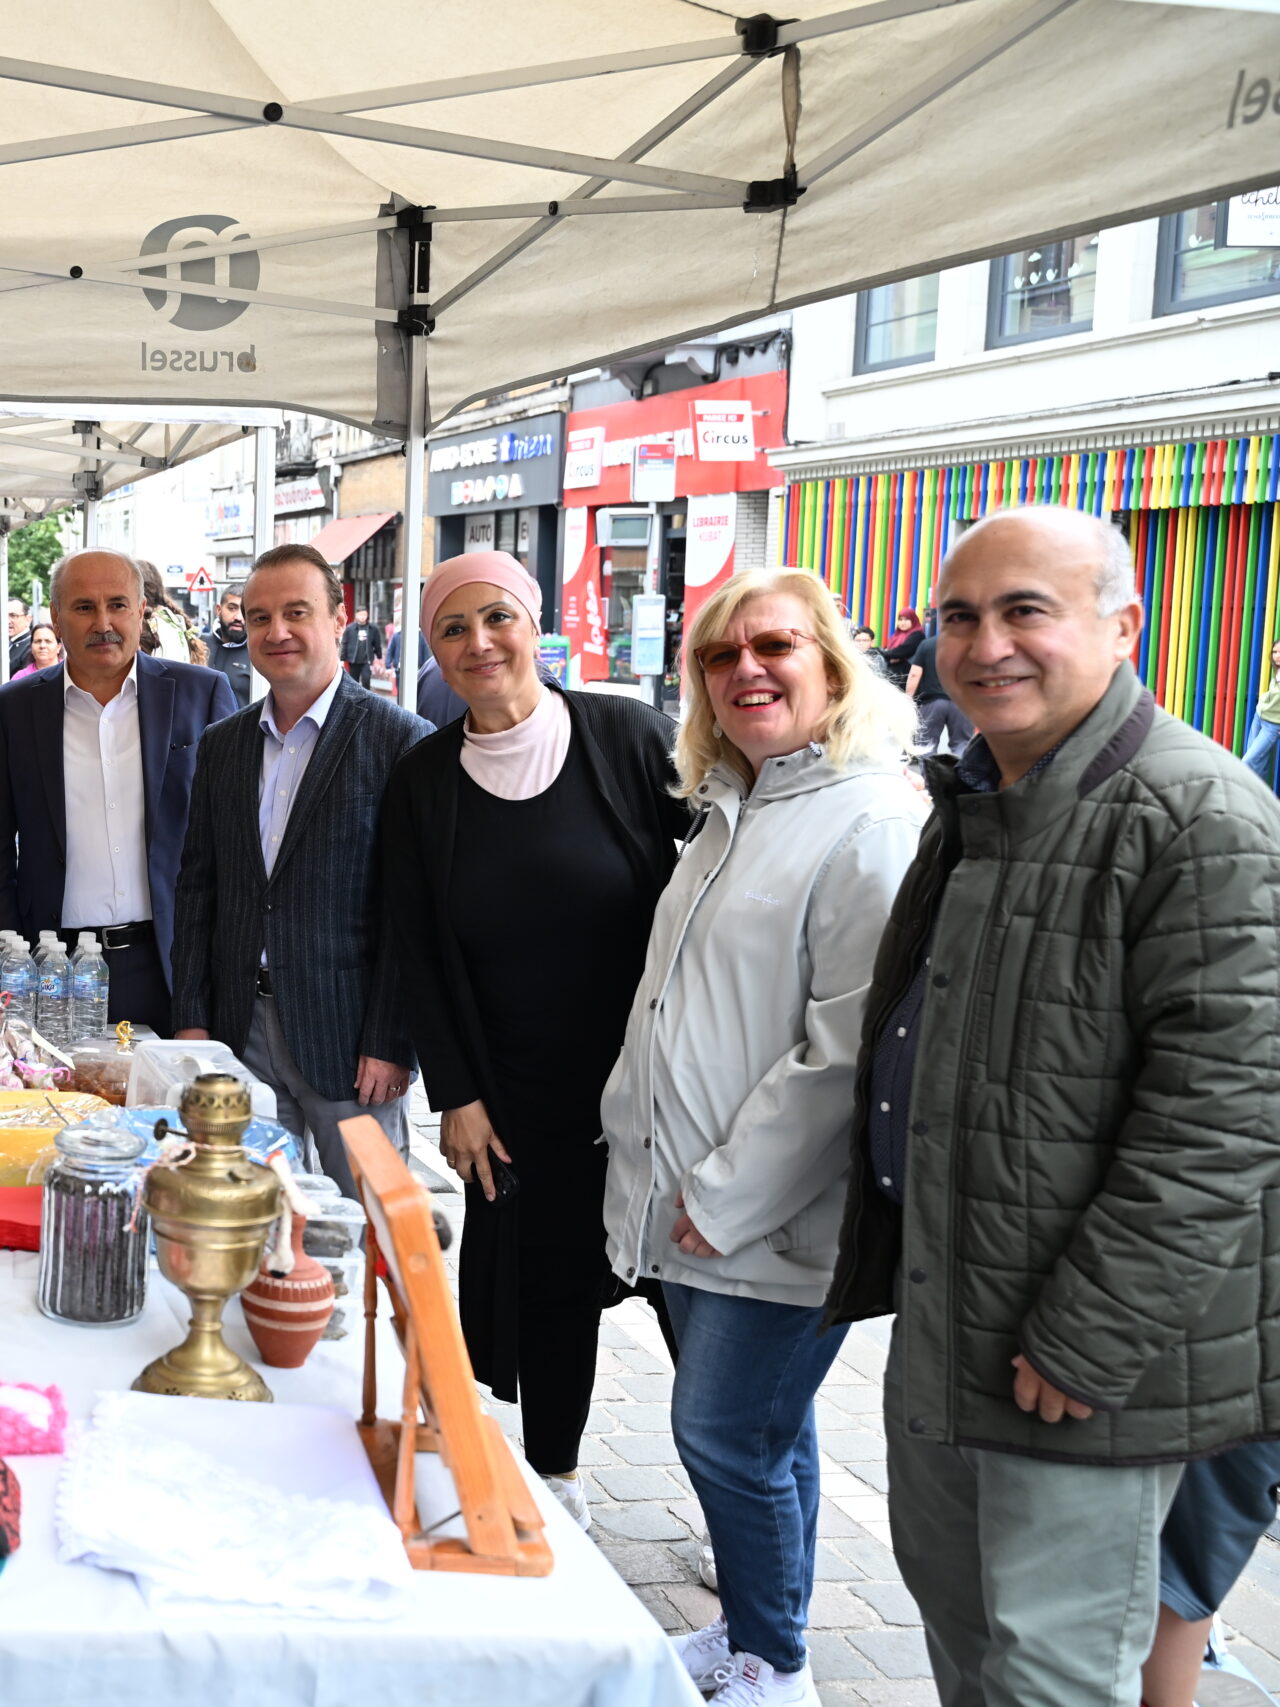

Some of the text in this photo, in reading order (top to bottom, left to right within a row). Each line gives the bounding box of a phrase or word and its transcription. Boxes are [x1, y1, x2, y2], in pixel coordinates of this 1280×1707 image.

[702, 430, 749, 445] Circus
[692, 515, 729, 528] LIBRAIRIE
[469, 524, 492, 543] AUTO
